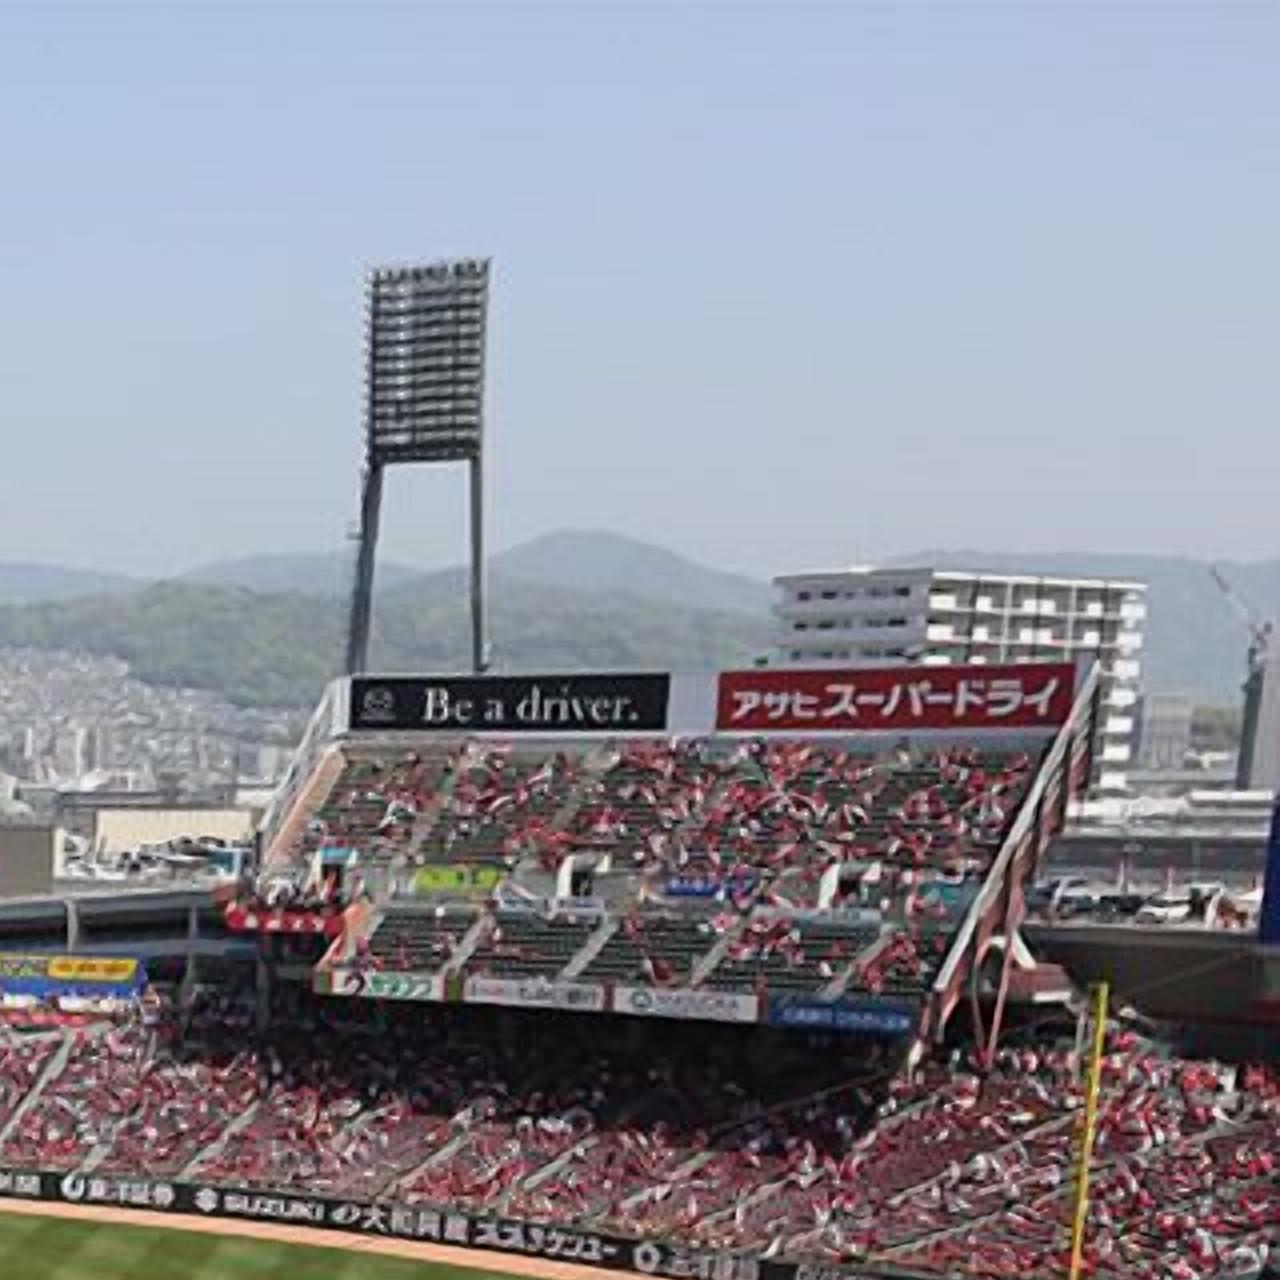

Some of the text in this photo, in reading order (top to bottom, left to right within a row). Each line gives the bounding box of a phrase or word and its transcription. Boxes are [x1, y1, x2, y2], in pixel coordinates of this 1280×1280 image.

[423, 682, 639, 722] Be a driver.
[730, 677, 1059, 719] アサヒスーパードライ
